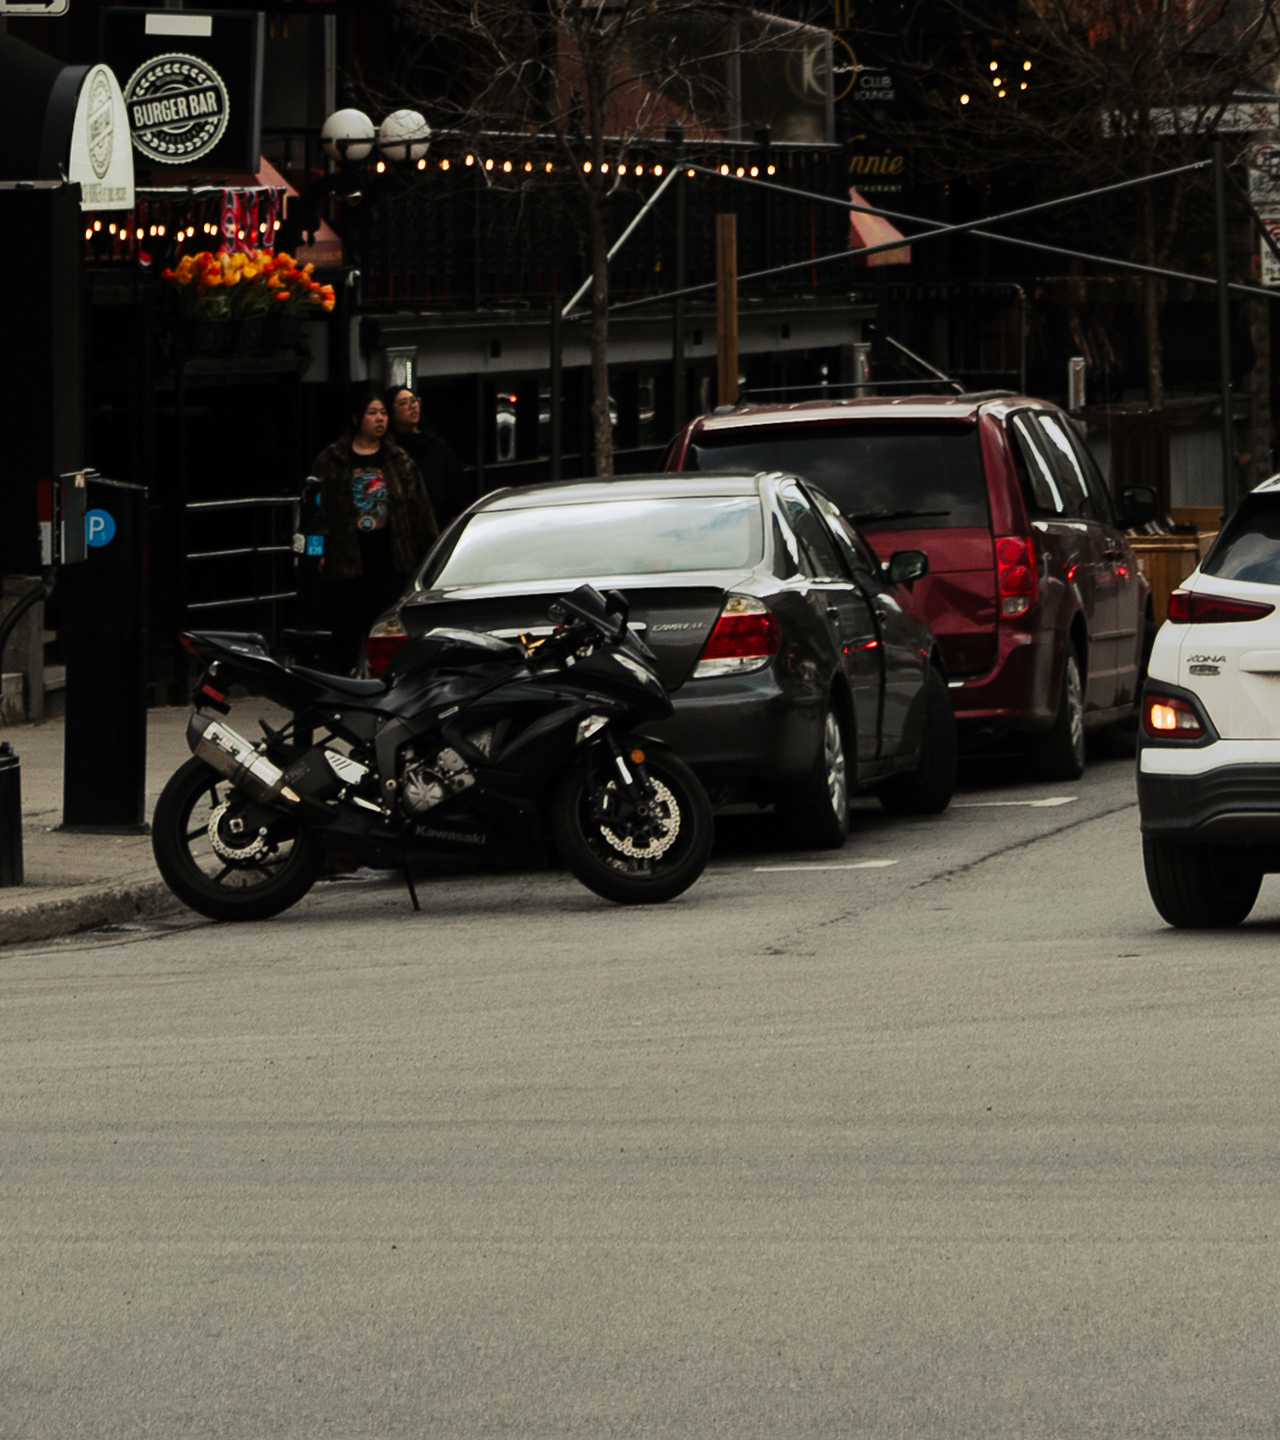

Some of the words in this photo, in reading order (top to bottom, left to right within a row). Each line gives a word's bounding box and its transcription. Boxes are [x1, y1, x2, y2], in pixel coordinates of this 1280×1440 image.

[860, 76, 892, 89] CLUB
[854, 90, 895, 101] LOUNGE
[133, 98, 188, 128] BURGER
[189, 91, 218, 117] BAR
[89, 516, 105, 541] P
[1187, 655, 1226, 663] KONA
[415, 824, 488, 846] Kawasaki
